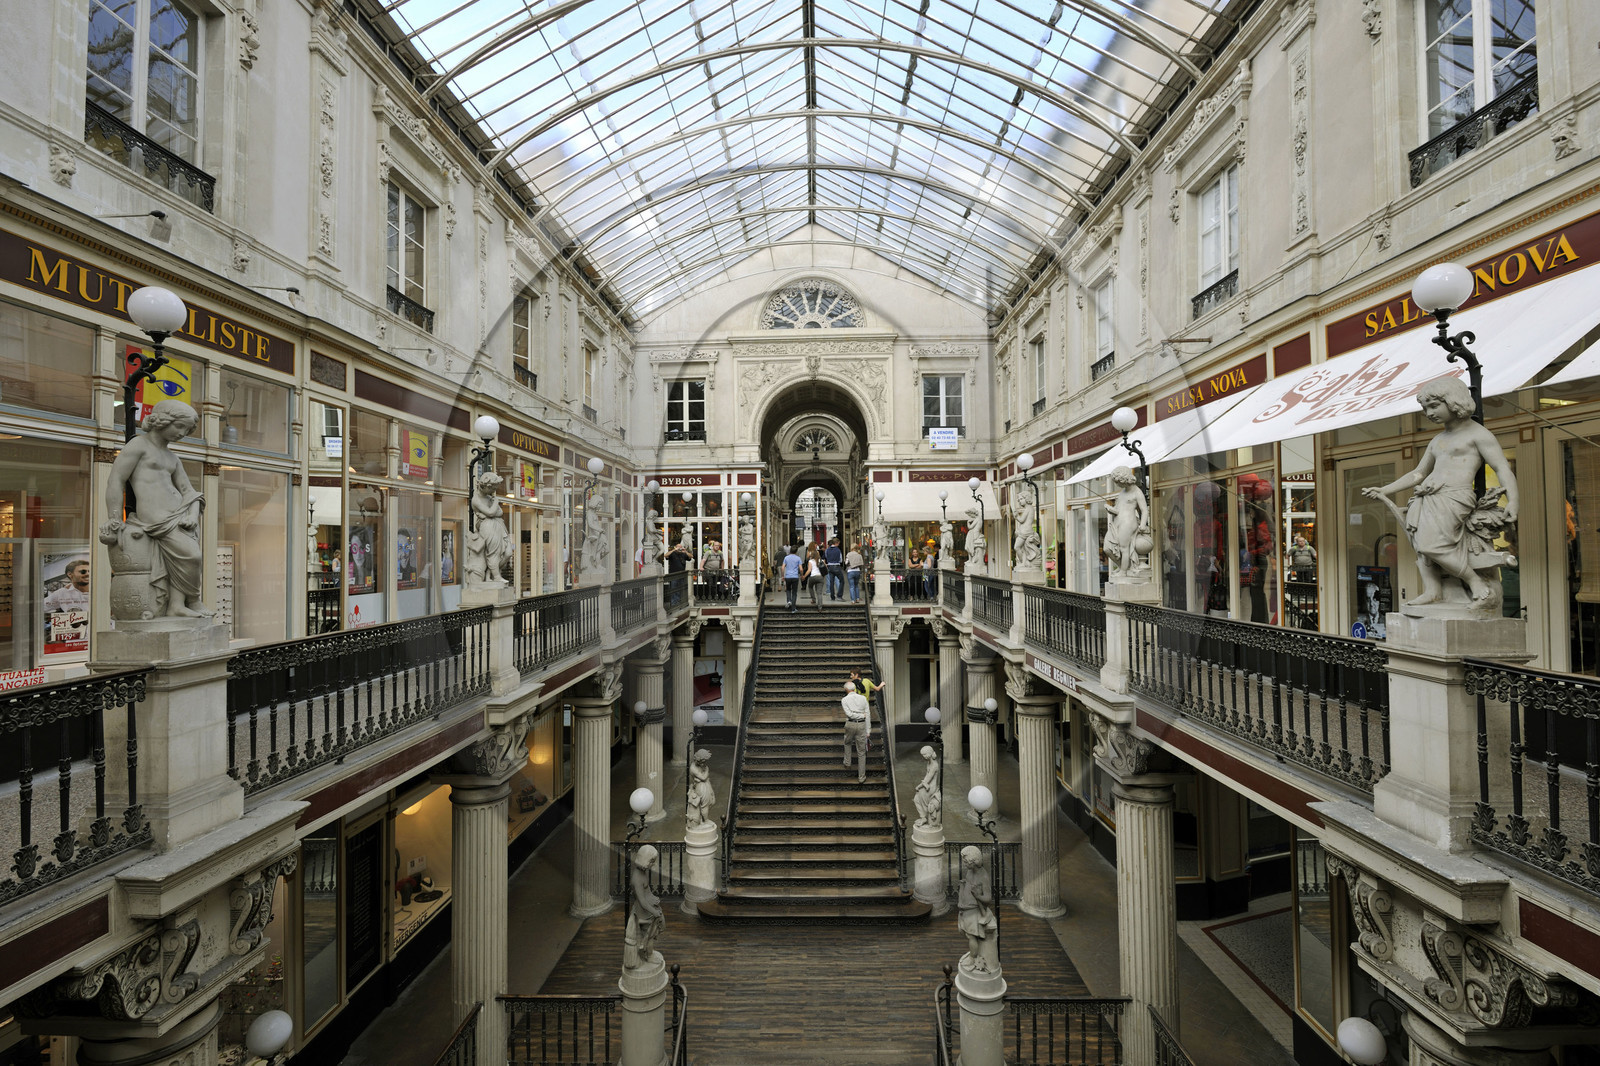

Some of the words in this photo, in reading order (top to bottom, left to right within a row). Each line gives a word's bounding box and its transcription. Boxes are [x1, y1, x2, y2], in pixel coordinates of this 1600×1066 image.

[25, 246, 271, 362] MUTLISTE
[1365, 297, 1429, 338] SAL
[1472, 233, 1580, 298] NOVA
[1167, 385, 1205, 414] SALSA
[1209, 367, 1248, 397] NOVA
[1253, 353, 1410, 424] Salsa
[512, 431, 549, 456] OPTICIEN
[661, 477, 702, 485] BYBLOS
[0, 665, 45, 681] TUALITÉ
[1034, 657, 1052, 678] GALERIE
[1053, 667, 1077, 692] REGNIER
[393, 911, 428, 948] EMERGENCE
